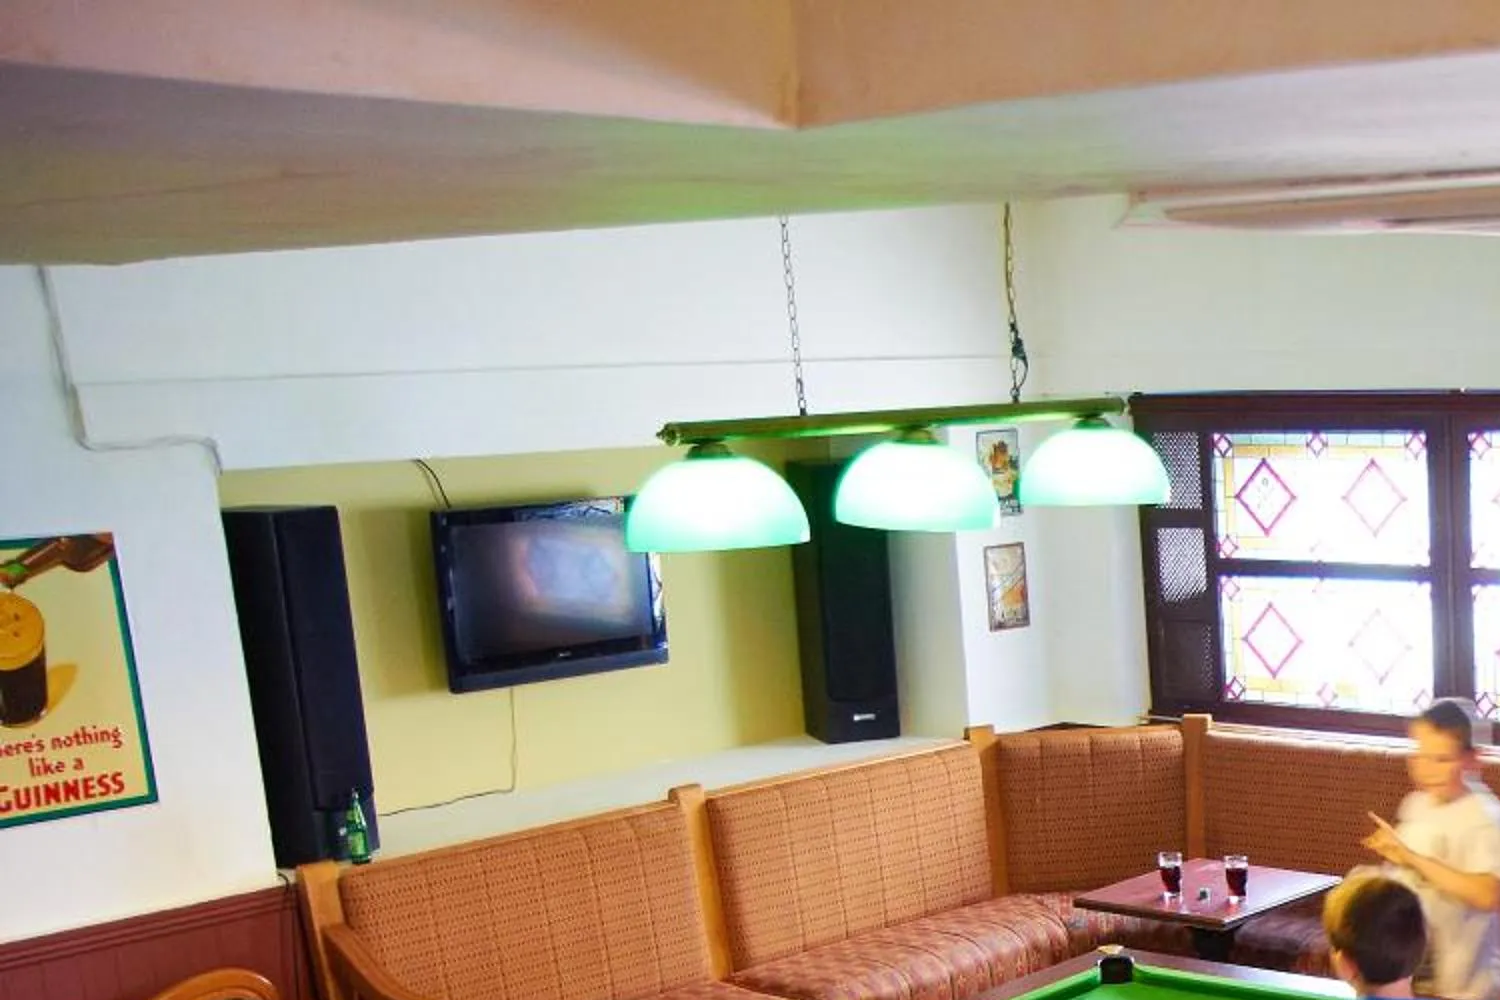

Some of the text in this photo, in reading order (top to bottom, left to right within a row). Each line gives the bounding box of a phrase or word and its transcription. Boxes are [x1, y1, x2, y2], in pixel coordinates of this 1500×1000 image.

[0, 726, 123, 758] ere's nothing
[28, 757, 84, 777] like a
[0, 772, 125, 812] GUINNESS
